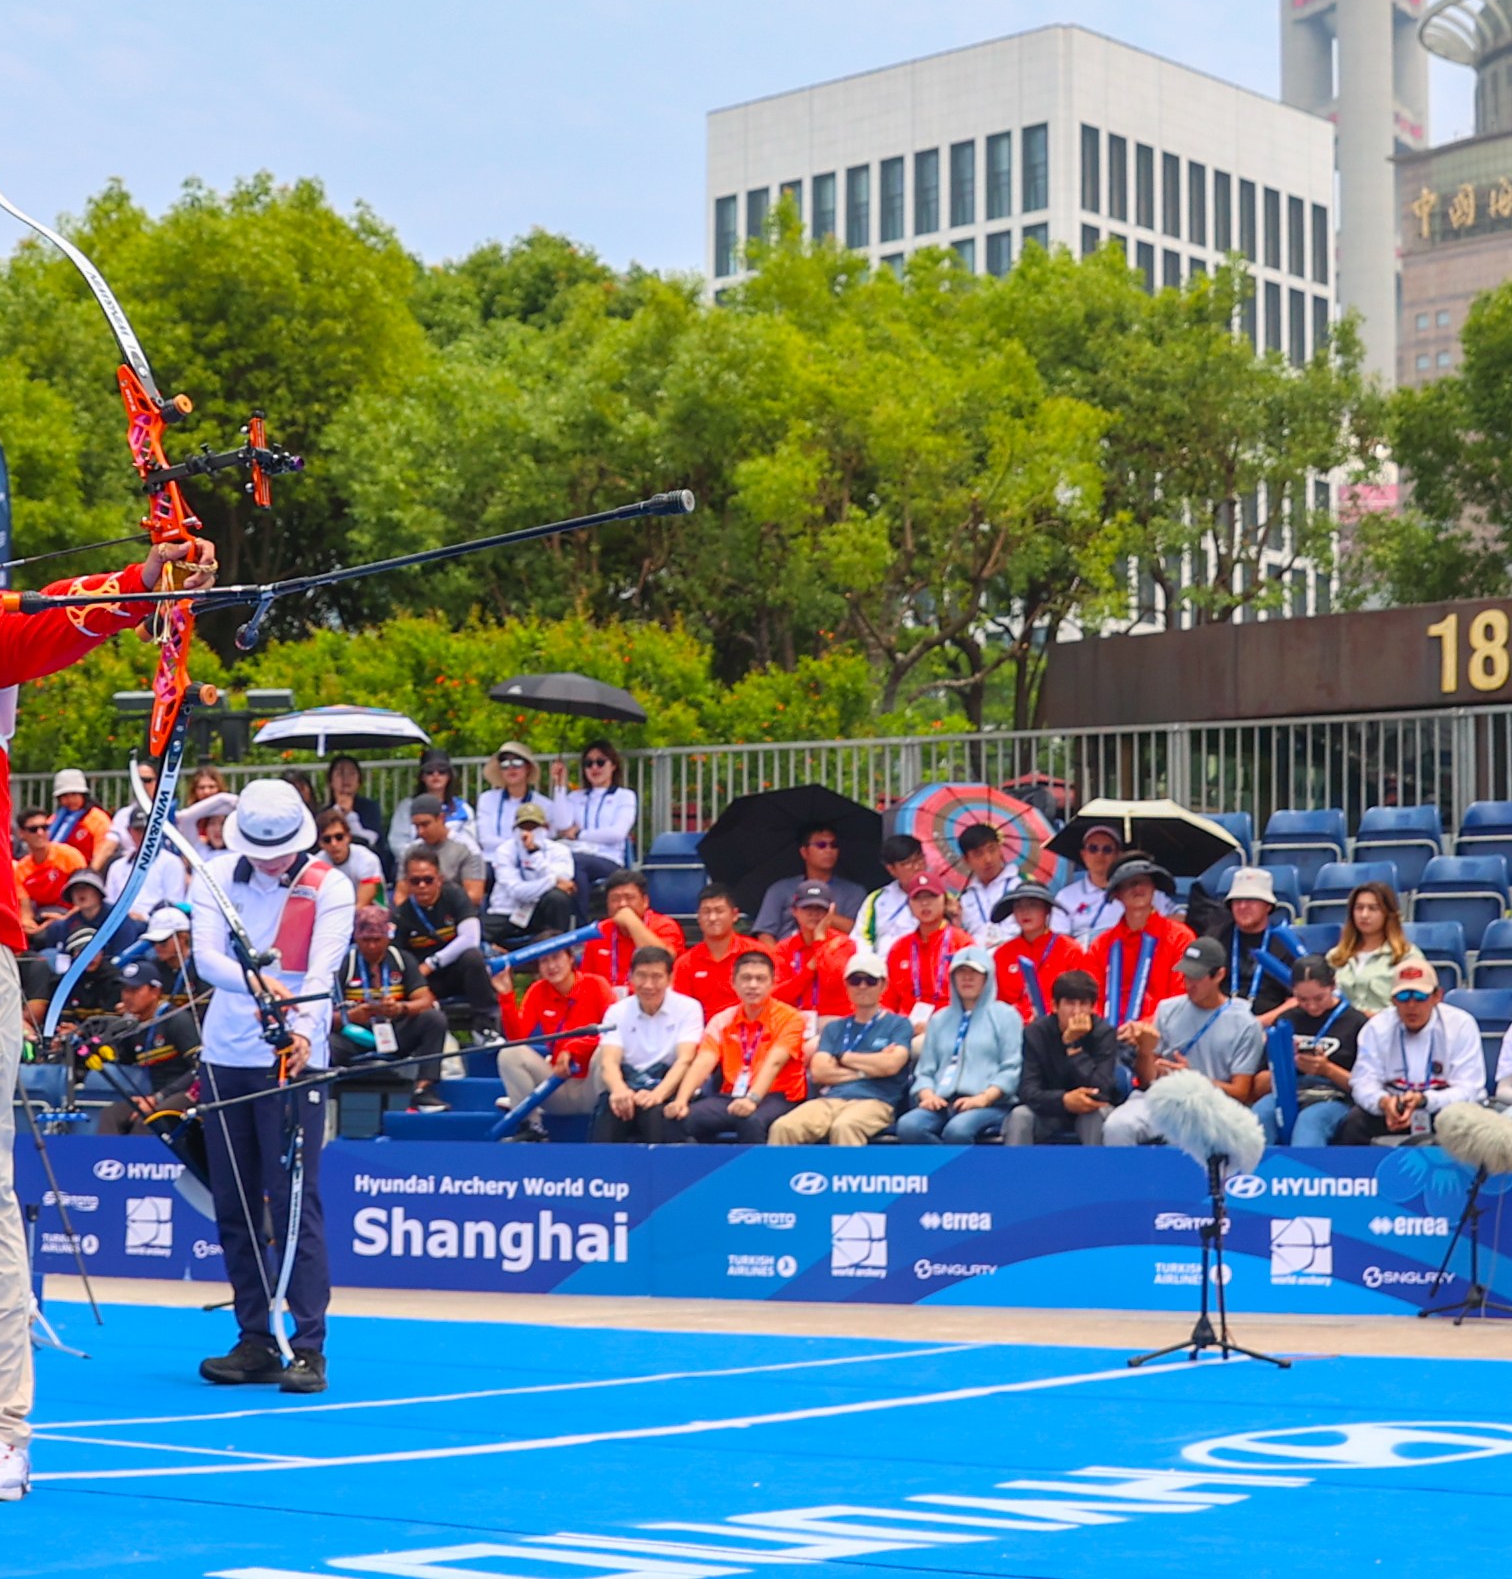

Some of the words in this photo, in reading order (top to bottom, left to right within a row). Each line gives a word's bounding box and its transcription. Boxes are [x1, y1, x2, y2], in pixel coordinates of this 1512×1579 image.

[138, 790, 170, 871] WIN&WIN
[354, 1174, 435, 1197] Hyundai
[439, 1176, 518, 1200] Archery
[523, 1177, 584, 1198] World
[589, 1178, 630, 1202] Cup
[832, 1174, 928, 1194] HYUNDAI
[1271, 1177, 1378, 1197] HYUNDAI
[727, 1209, 796, 1229] SPORTOTO
[942, 1211, 991, 1231] errea
[1393, 1215, 1449, 1236] errea
[352, 1206, 629, 1272] Shanghai
[727, 1254, 774, 1266] TURKISH
[726, 1265, 774, 1278] AIRLINES
[205, 1466, 1312, 1579] HYUND
